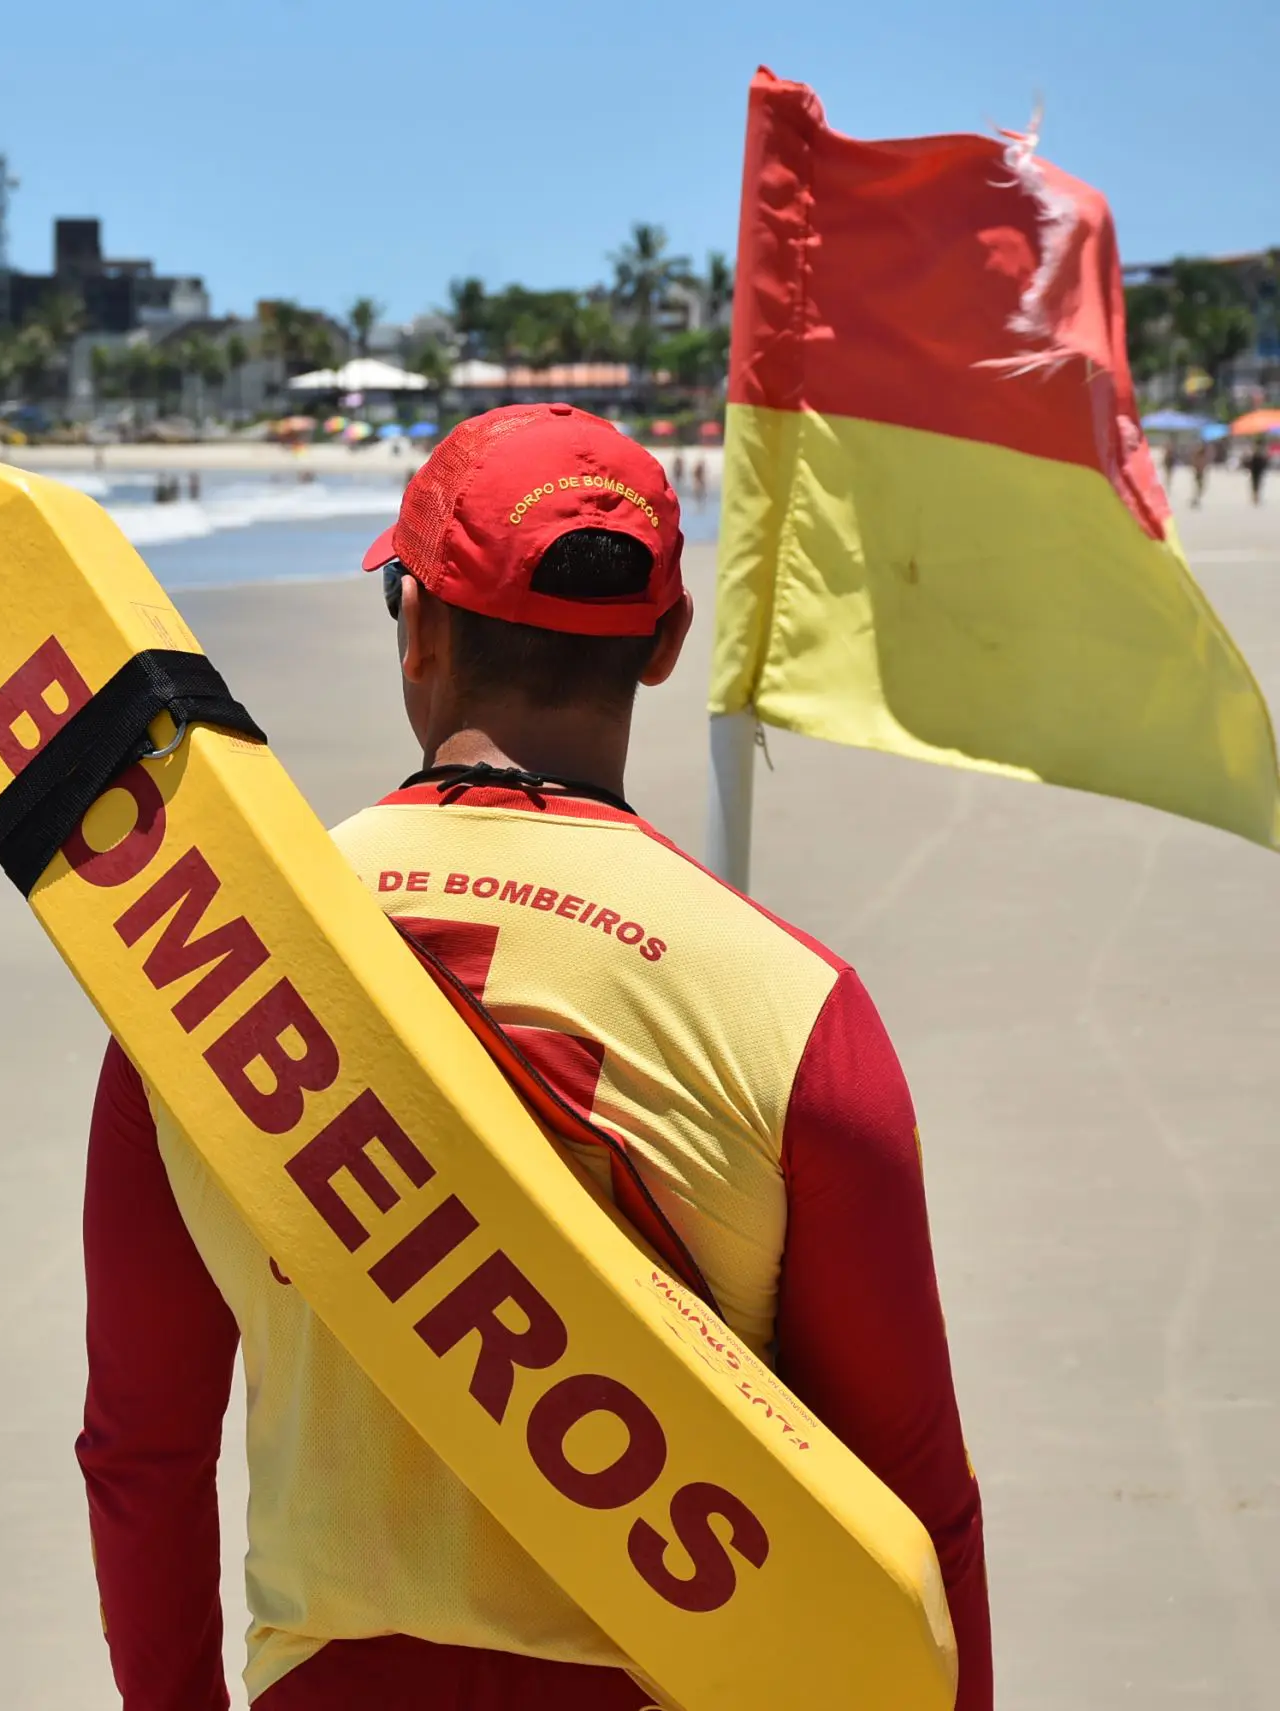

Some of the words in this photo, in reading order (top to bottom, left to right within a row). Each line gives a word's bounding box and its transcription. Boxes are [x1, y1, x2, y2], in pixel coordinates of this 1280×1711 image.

[509, 482, 555, 525] CORPO
[558, 476, 581, 490] DE
[583, 475, 660, 529] BOMBEIROS
[378, 870, 430, 892] DE
[443, 873, 667, 962] BOMBEIROS
